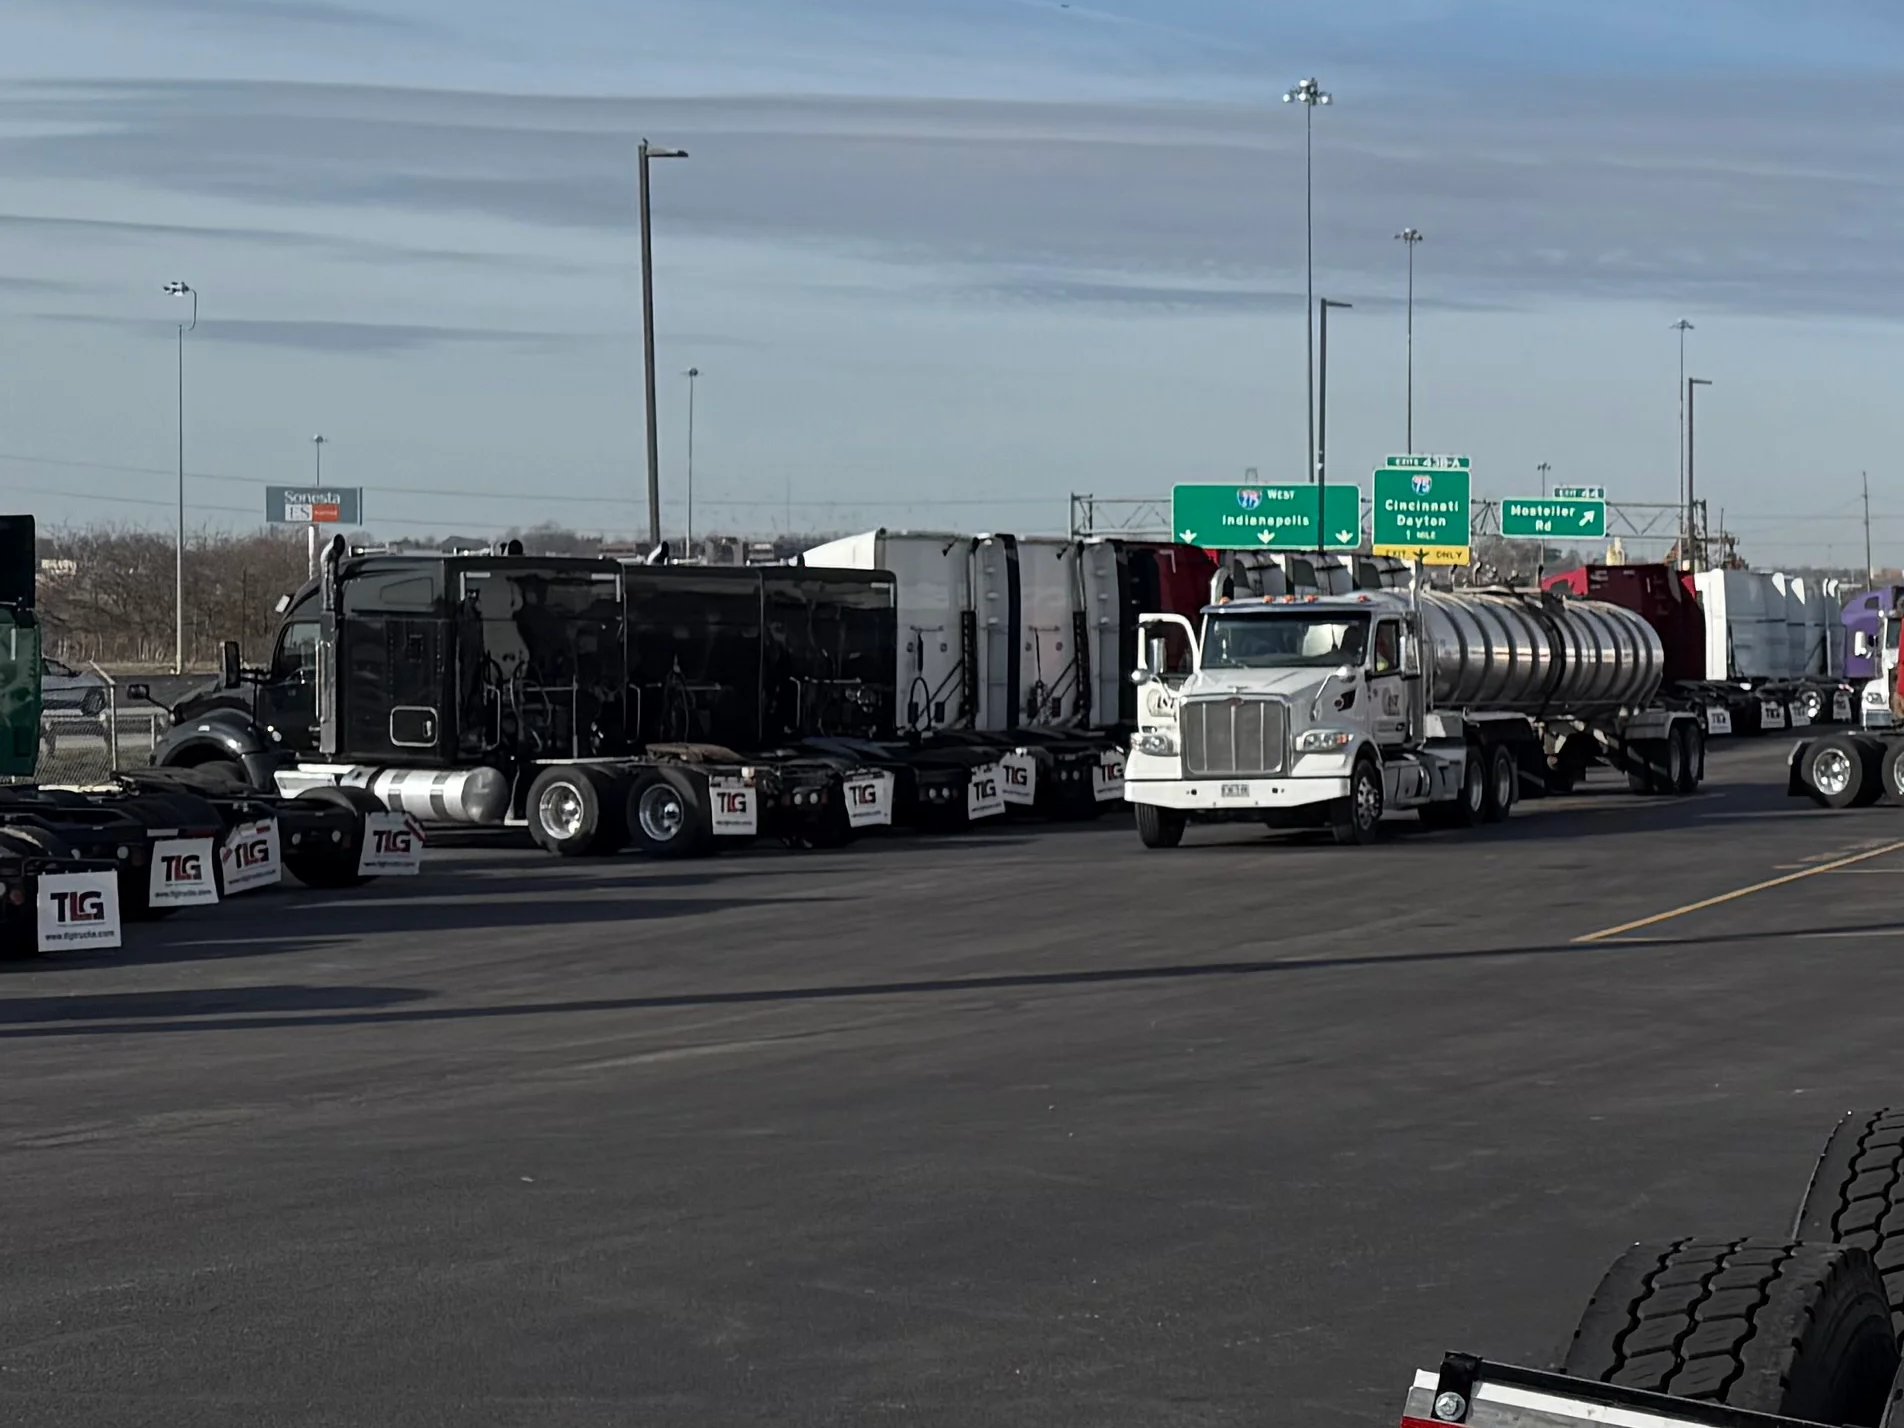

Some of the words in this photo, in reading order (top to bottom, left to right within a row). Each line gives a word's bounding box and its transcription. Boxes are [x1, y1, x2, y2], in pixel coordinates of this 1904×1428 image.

[1266, 489, 1295, 500] WEST
[1414, 477, 1431, 493] 75
[284, 490, 341, 504] Sonesta
[1384, 498, 1459, 513] Cincinnati
[1510, 504, 1576, 518] Mosteller
[1222, 514, 1310, 529] Indianapolis
[1396, 513, 1447, 529] Dayton
[1535, 519, 1552, 532] Rd
[1003, 764, 1028, 786] TLG
[849, 784, 877, 807] TLG
[973, 778, 997, 801] TLG
[716, 791, 747, 814] TLG
[372, 829, 412, 854] TLG
[234, 838, 270, 869] TLG
[161, 853, 203, 882] TLG
[50, 890, 105, 923] TLG
